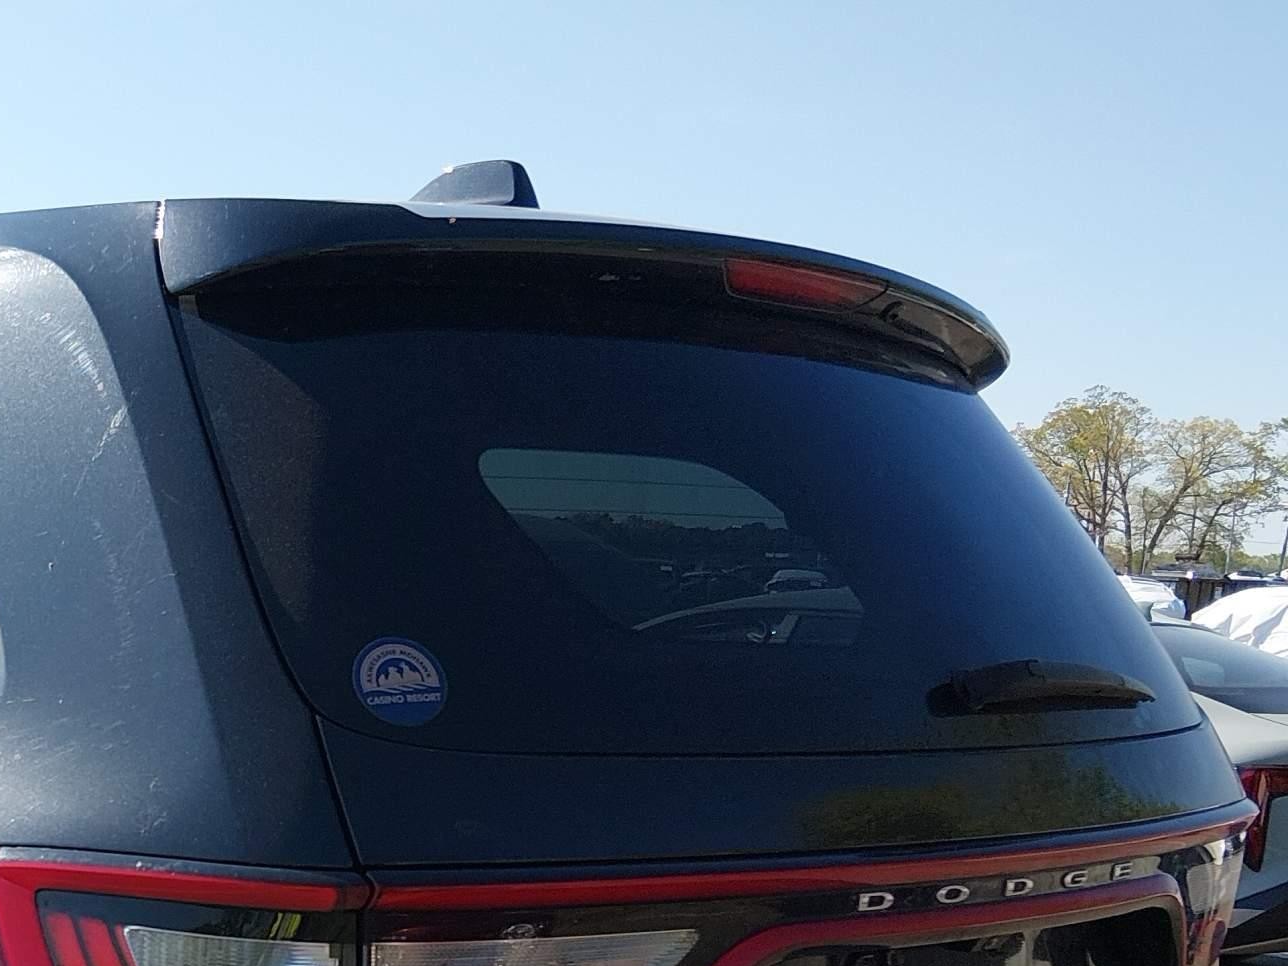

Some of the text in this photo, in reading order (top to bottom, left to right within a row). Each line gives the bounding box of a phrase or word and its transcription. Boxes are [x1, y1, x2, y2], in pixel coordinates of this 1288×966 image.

[367, 692, 441, 705] CASINO RESORT
[856, 862, 1133, 913] DODGE
